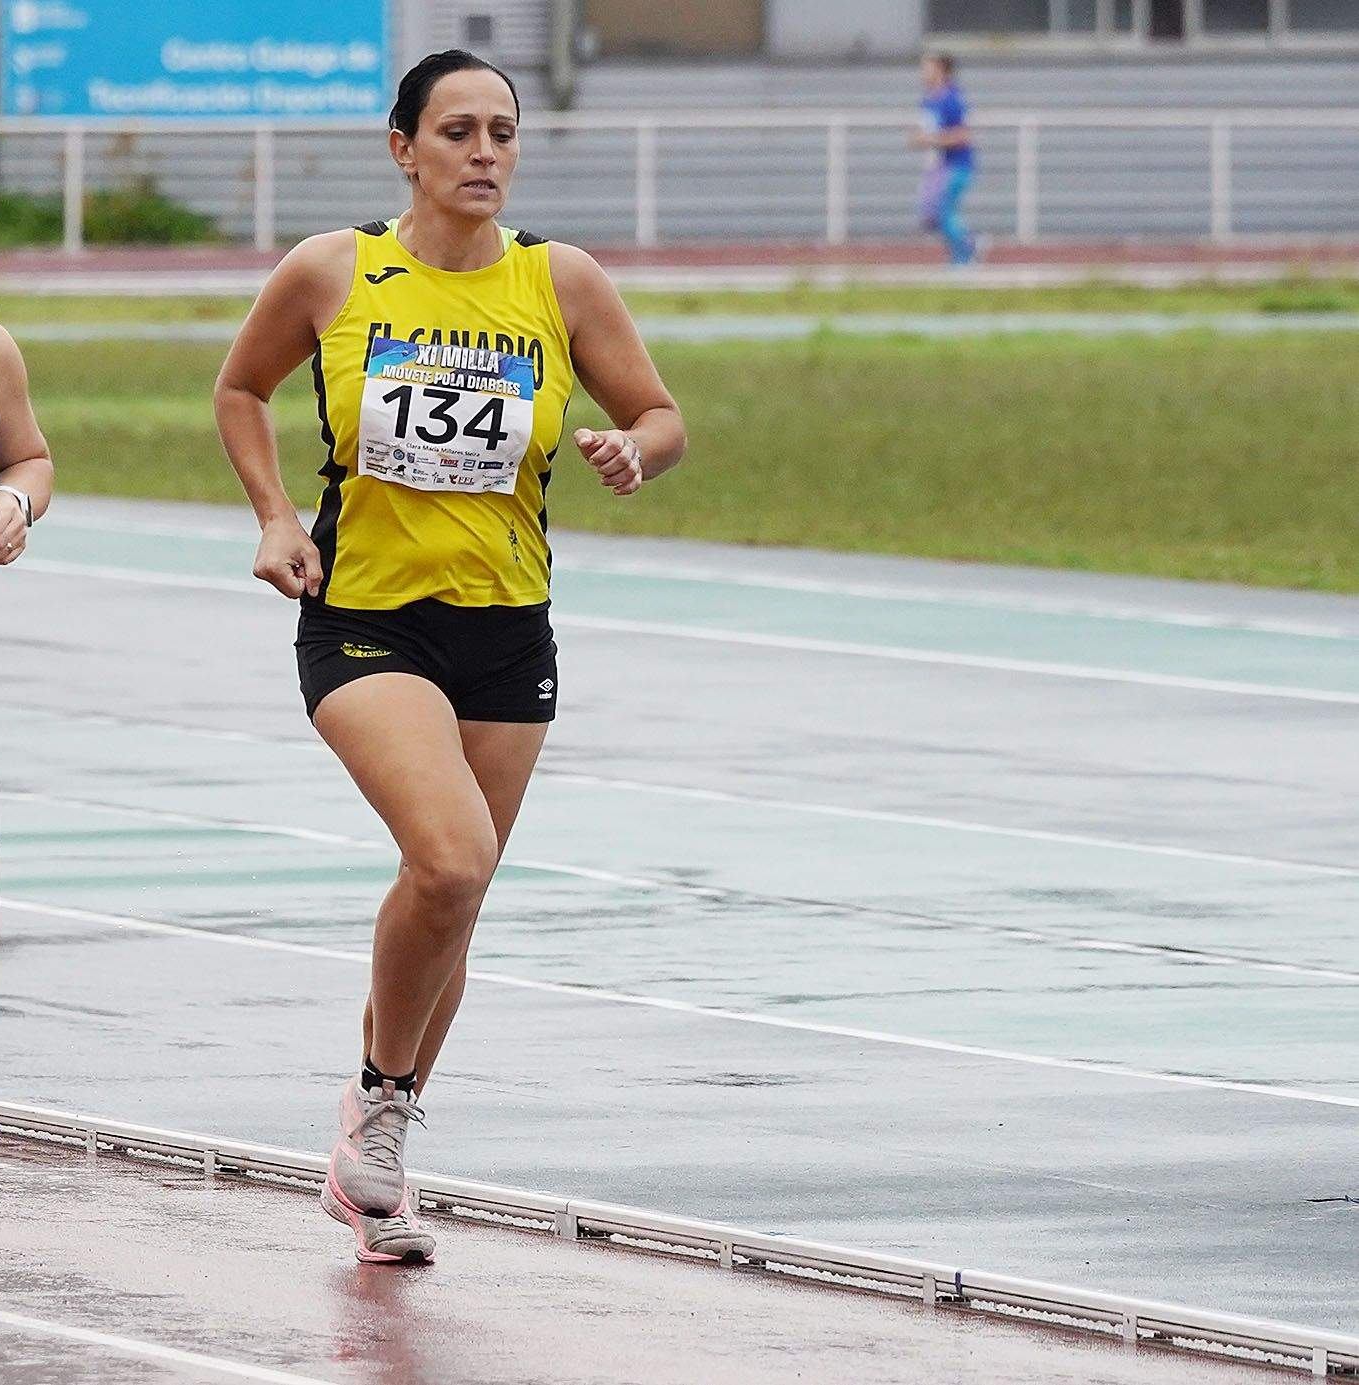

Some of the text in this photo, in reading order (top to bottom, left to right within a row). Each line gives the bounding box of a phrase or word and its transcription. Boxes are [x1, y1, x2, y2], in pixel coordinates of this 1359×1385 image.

[415, 344, 500, 374] XI MILLA
[434, 371, 465, 388] POLA
[467, 375, 521, 396] DIABETES
[382, 385, 508, 450] 134
